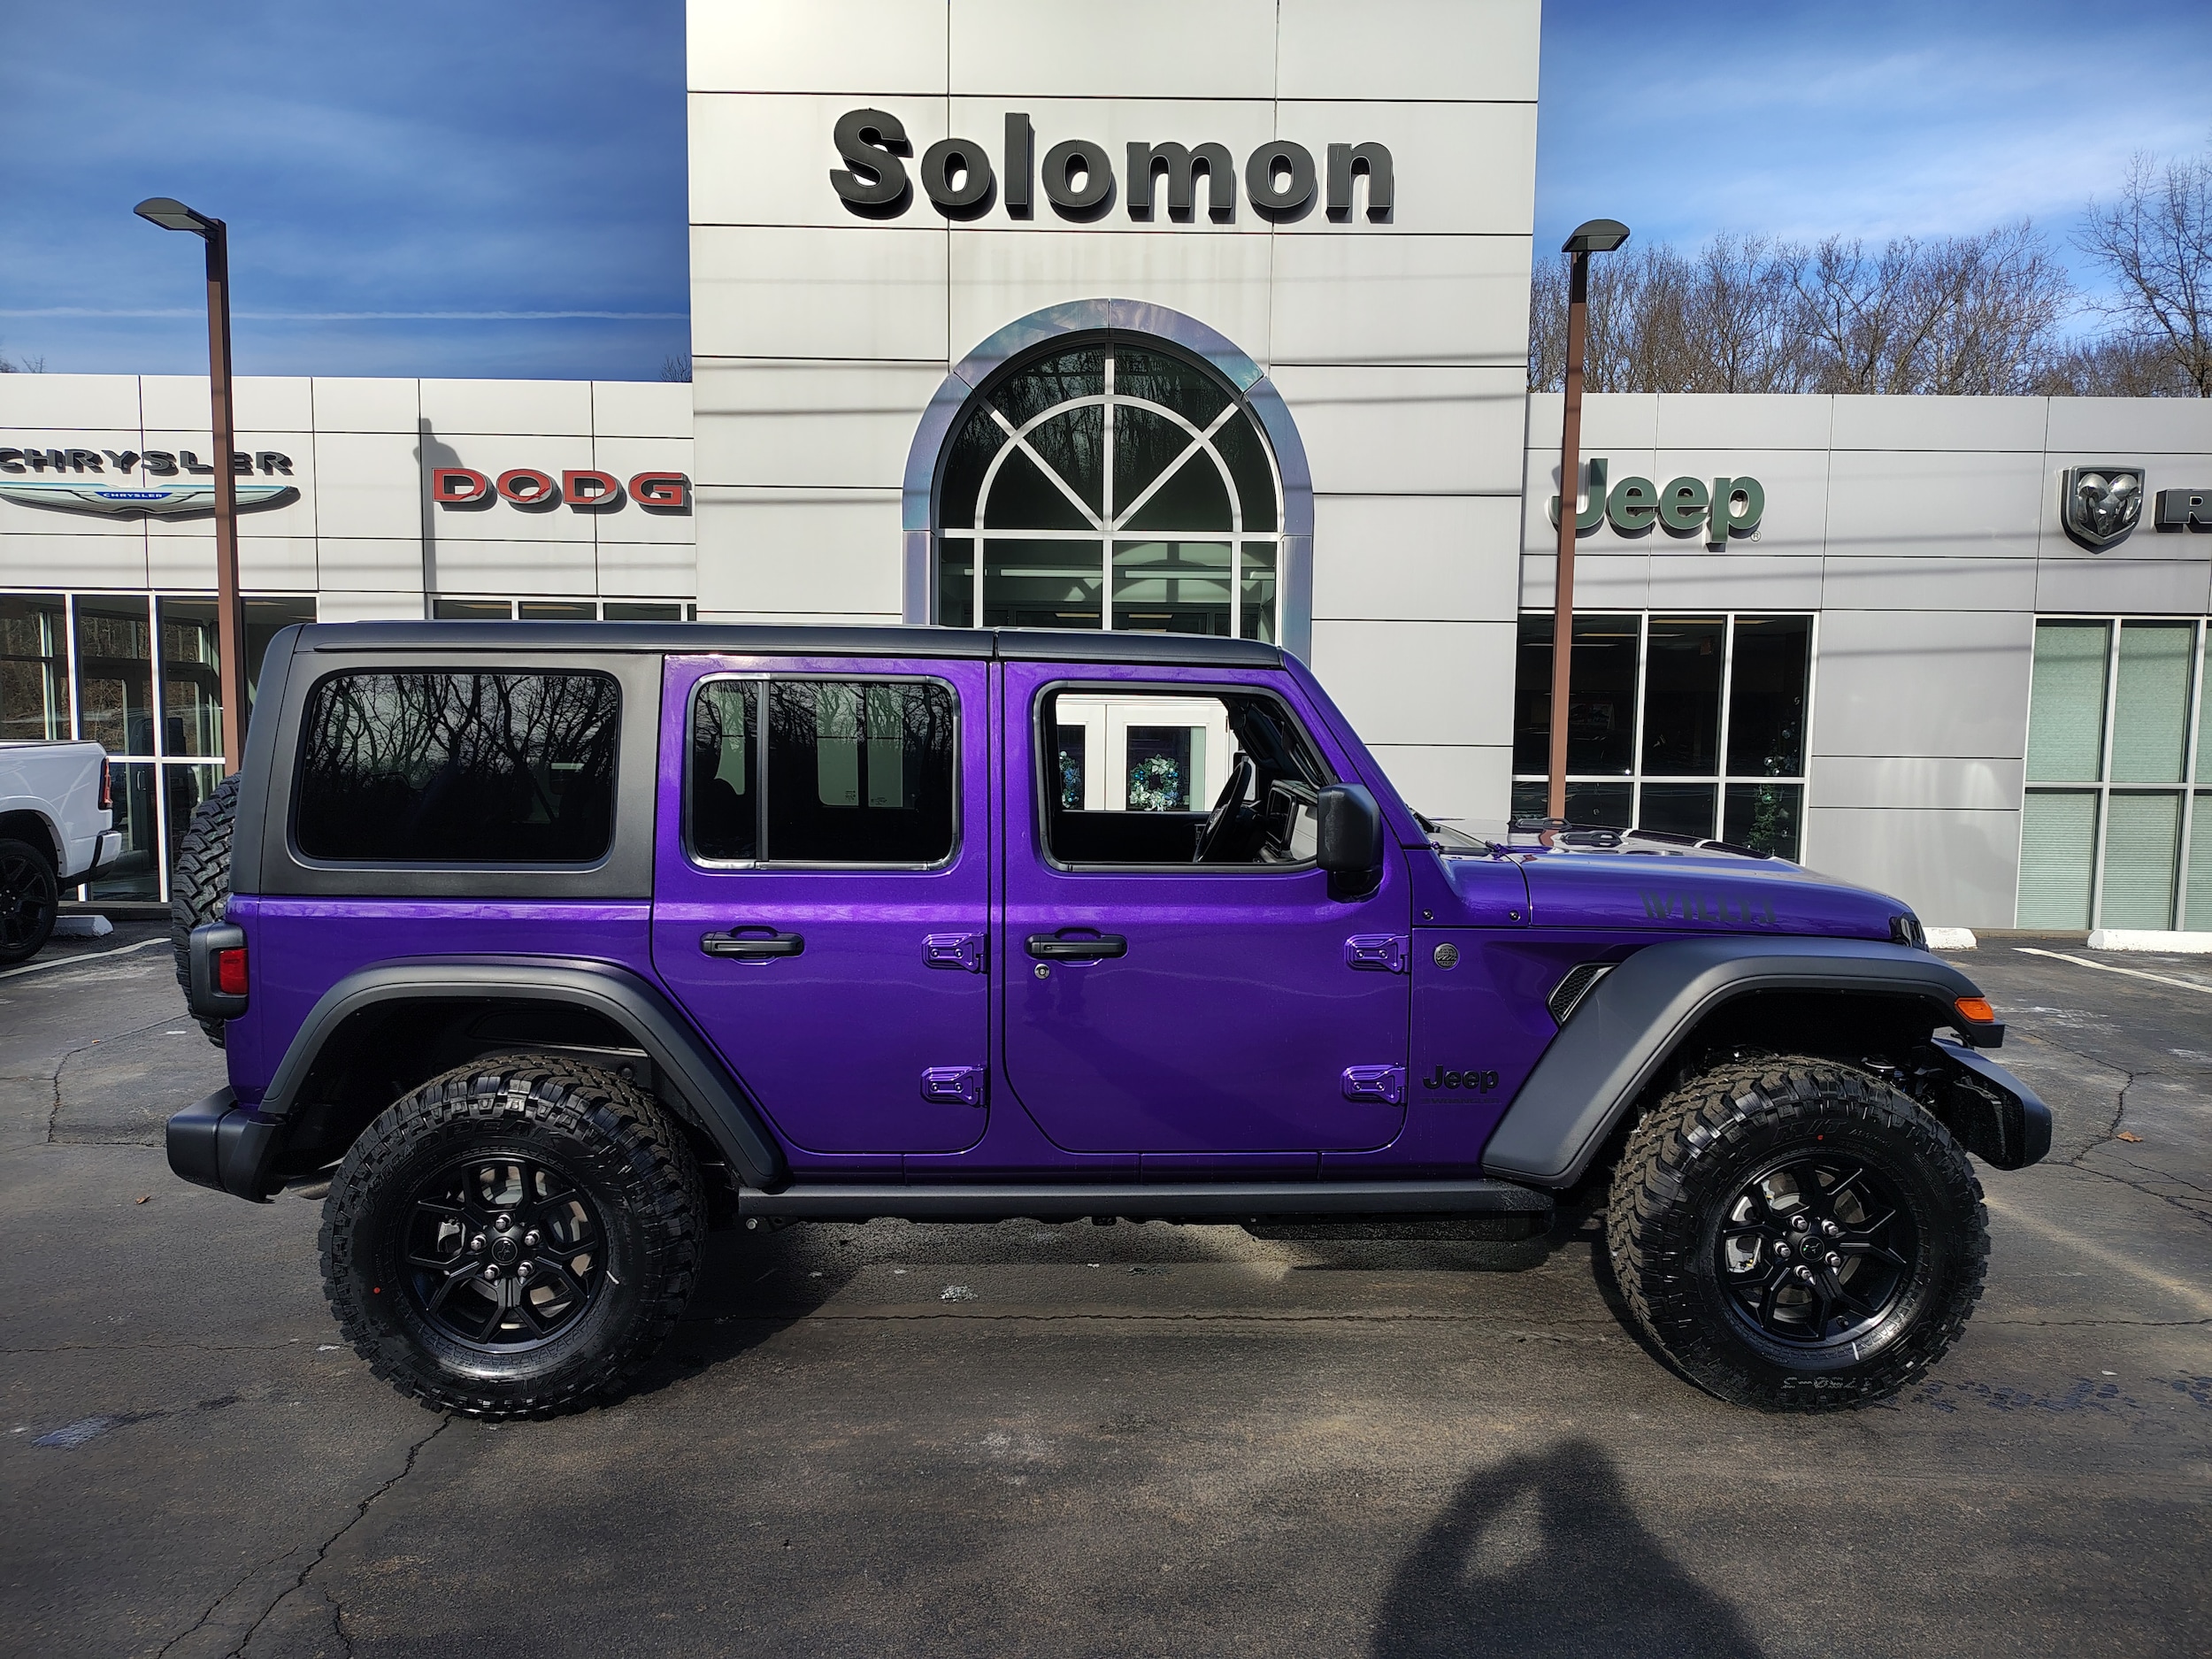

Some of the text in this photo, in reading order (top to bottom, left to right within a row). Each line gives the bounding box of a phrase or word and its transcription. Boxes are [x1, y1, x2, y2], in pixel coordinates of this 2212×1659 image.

[830, 108, 1394, 219] Solomon
[1549, 457, 1765, 549] Jeep
[1638, 888, 1777, 924] WILLYS
[1423, 1064, 1500, 1094] Jeep
